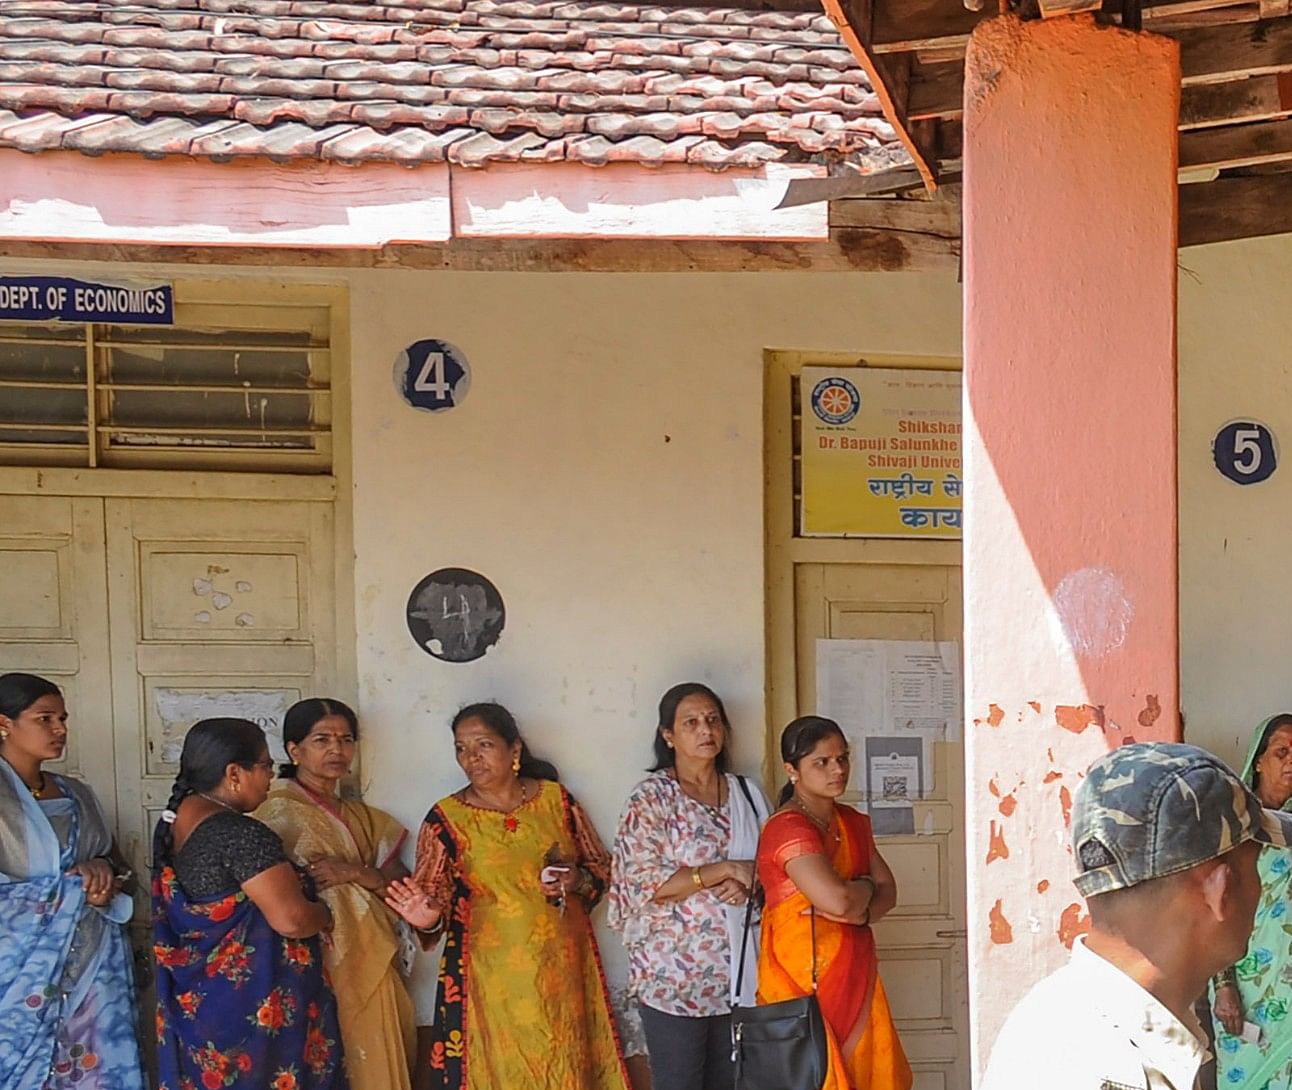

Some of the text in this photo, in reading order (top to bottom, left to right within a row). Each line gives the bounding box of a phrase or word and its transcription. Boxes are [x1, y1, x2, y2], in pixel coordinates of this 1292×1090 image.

[0, 286, 166, 314] DEPT. OF ECONOMICS
[413, 352, 450, 400] 4
[819, 436, 957, 451] Dr. Bapuji Salunkhe
[1233, 430, 1262, 474] 5
[868, 454, 917, 468] Shivaji
[868, 473, 934, 499] राष्ट्रीय
